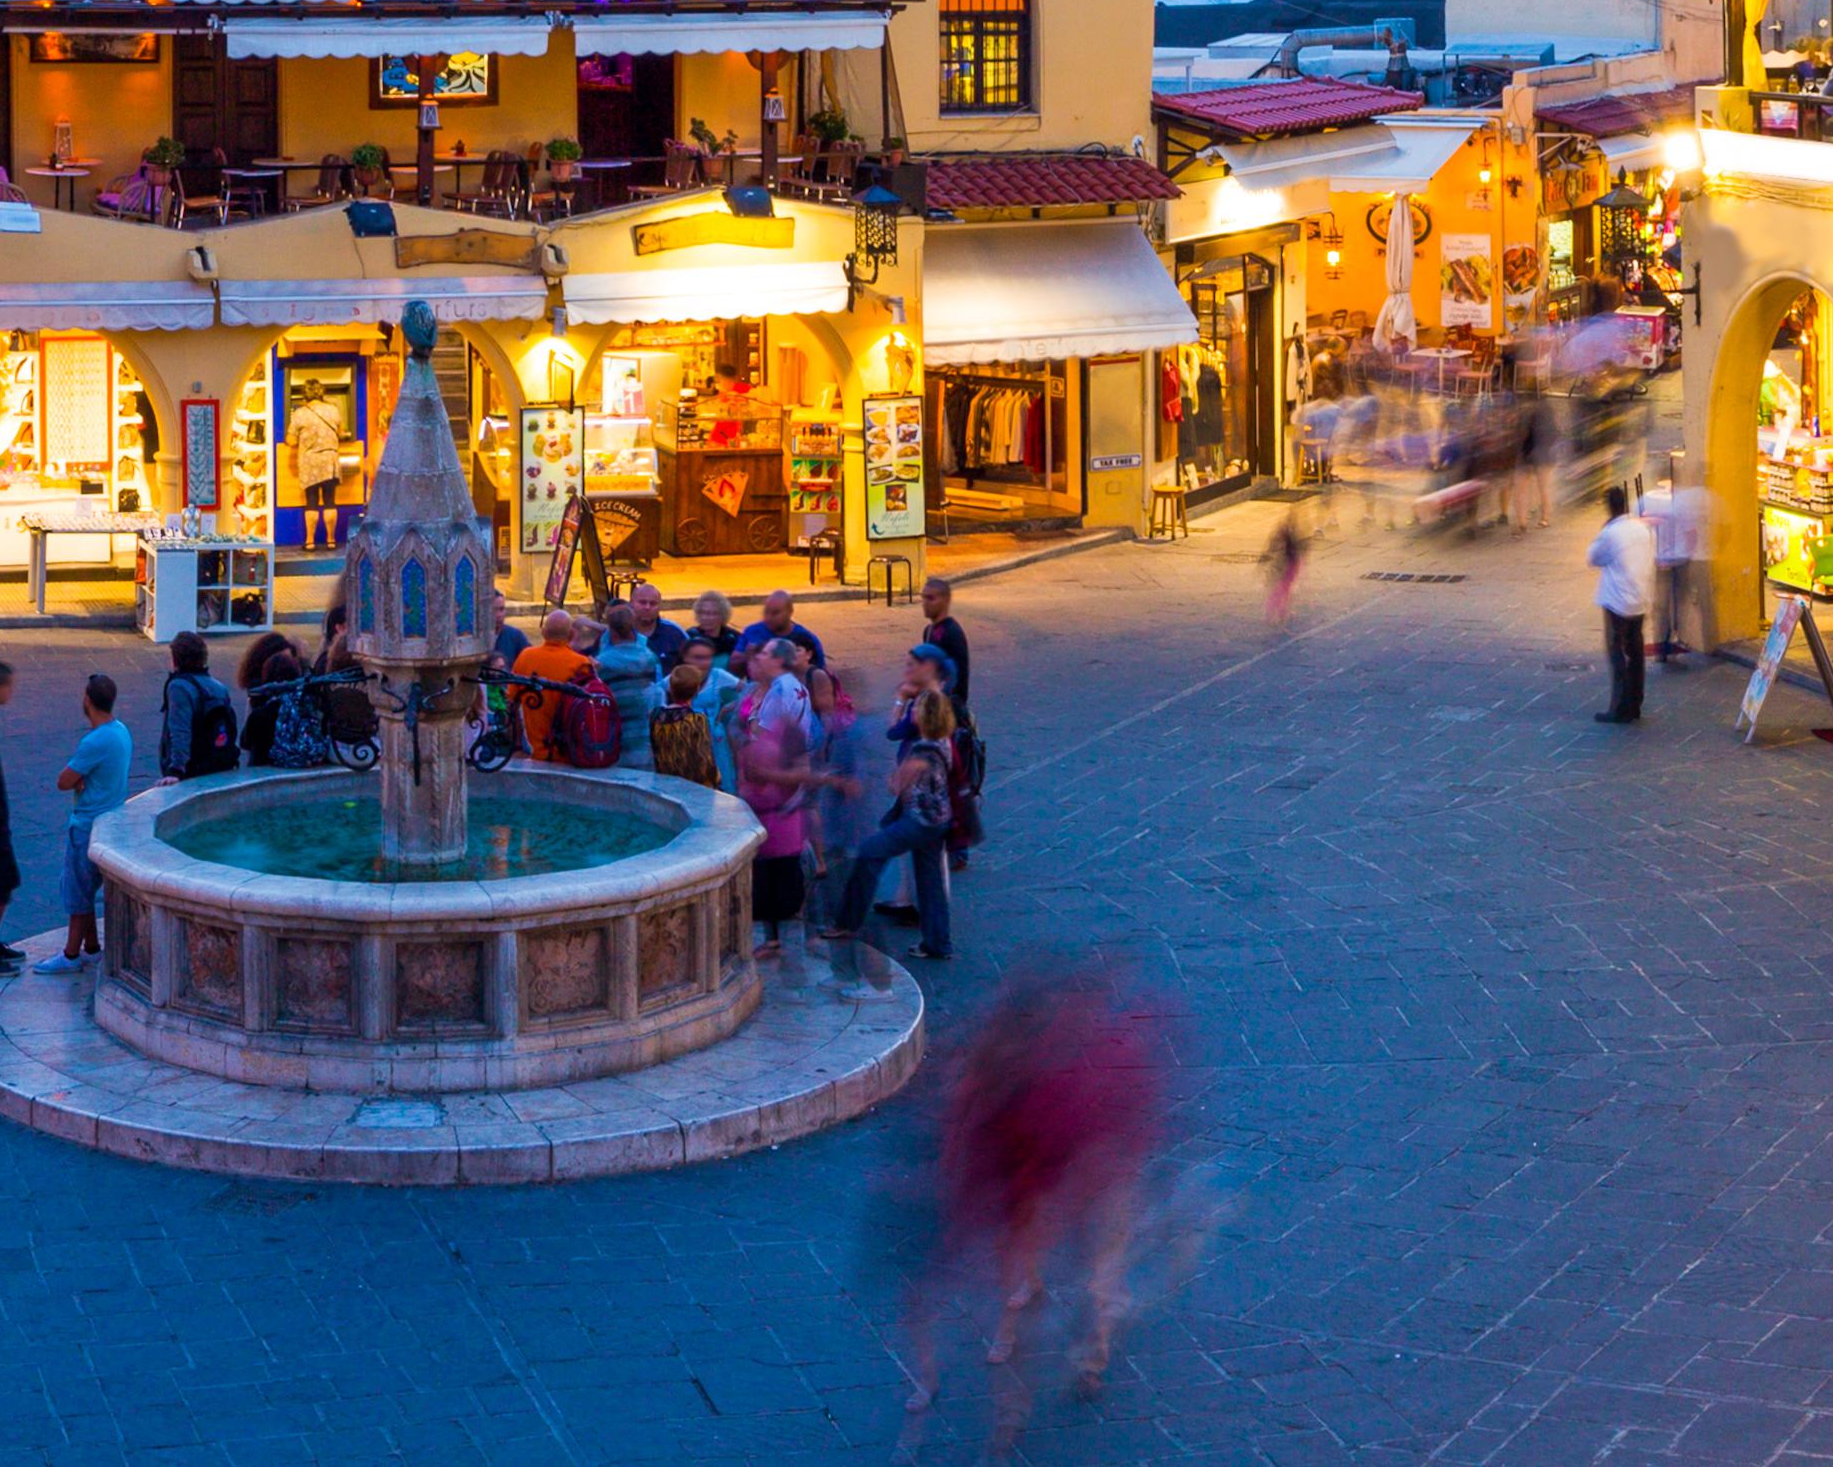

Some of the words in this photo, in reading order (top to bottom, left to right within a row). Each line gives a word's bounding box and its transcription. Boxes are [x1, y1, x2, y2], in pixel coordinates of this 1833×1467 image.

[1116, 457, 1132, 465] FREE
[594, 500, 613, 511] ICE
[612, 501, 642, 520] CREAM
